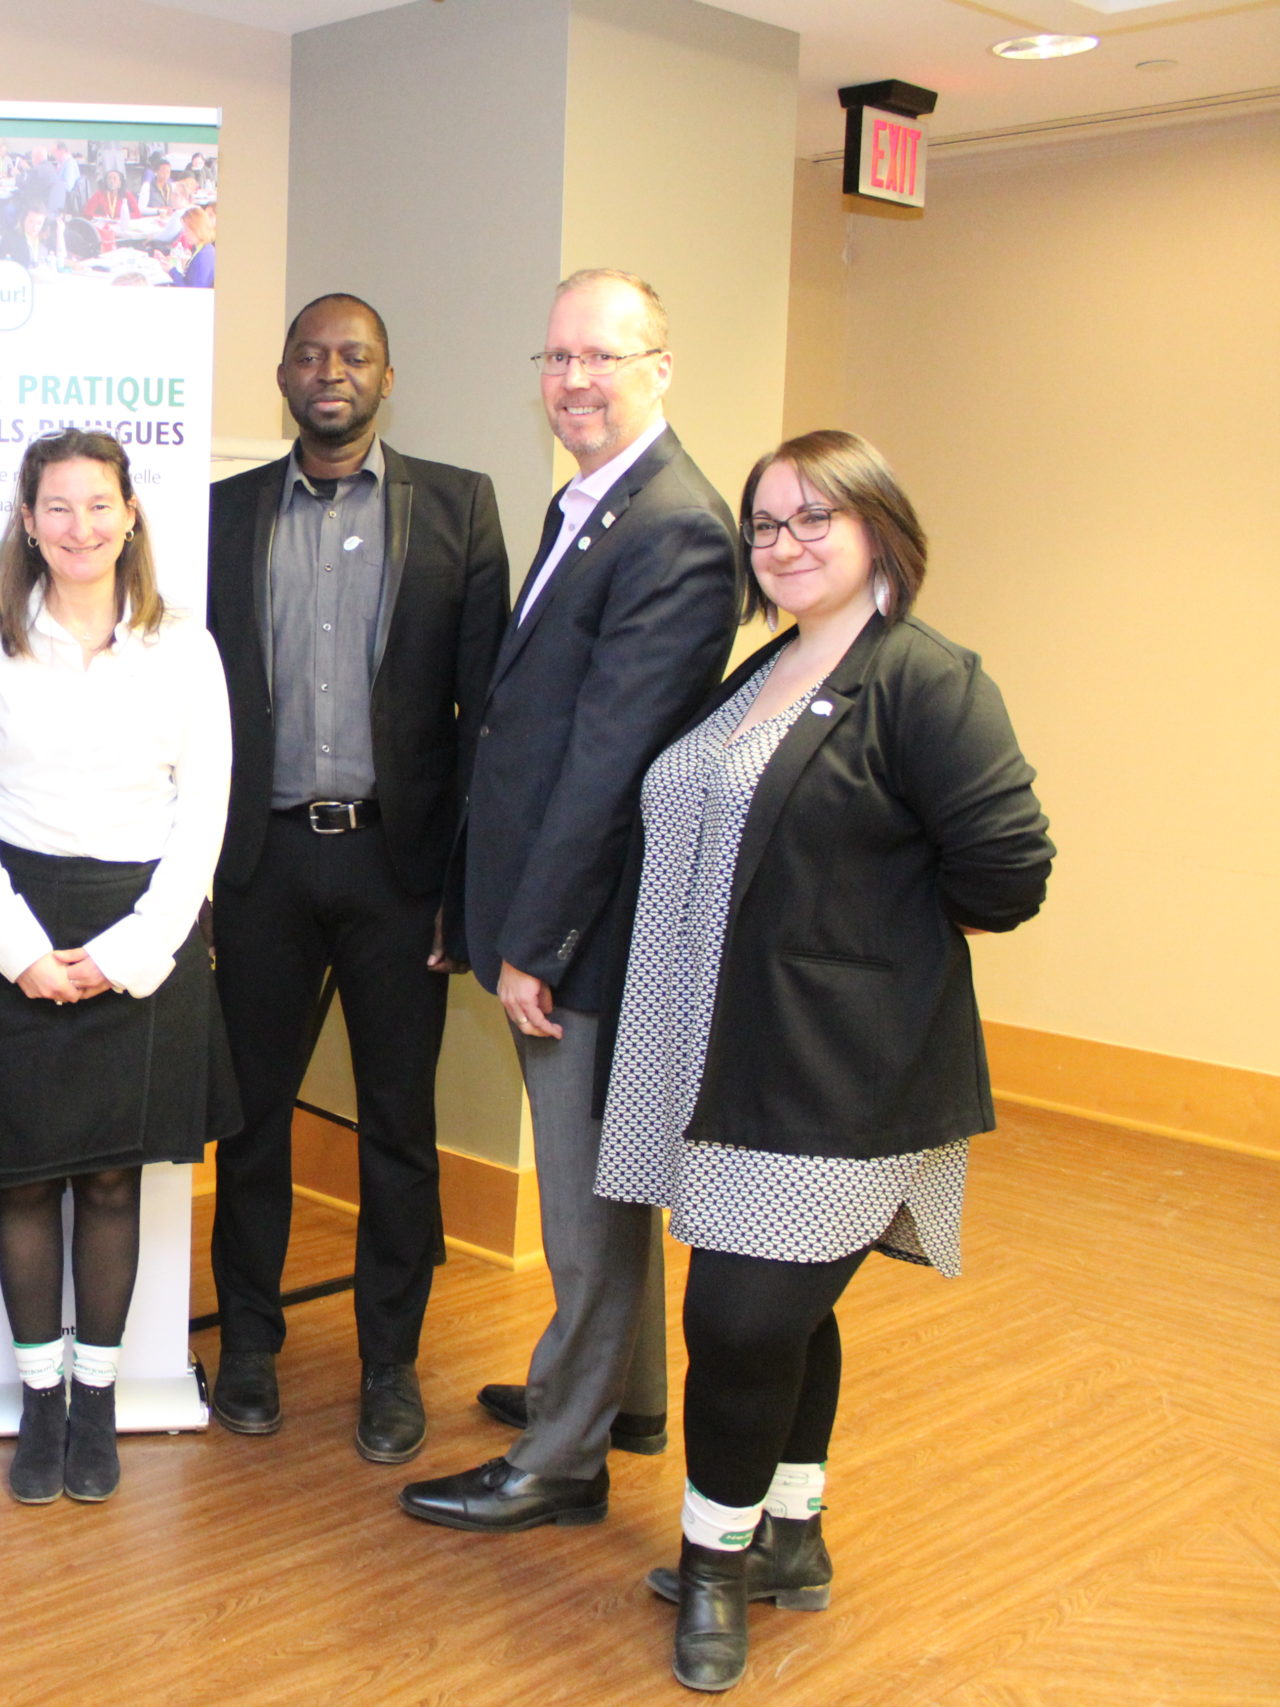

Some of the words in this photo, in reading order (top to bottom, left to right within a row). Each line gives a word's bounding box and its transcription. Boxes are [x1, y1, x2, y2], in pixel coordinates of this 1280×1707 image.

[871, 119, 922, 196] EXIT
[18, 374, 185, 413] PRATIQUE
[38, 419, 184, 445] BGUES
